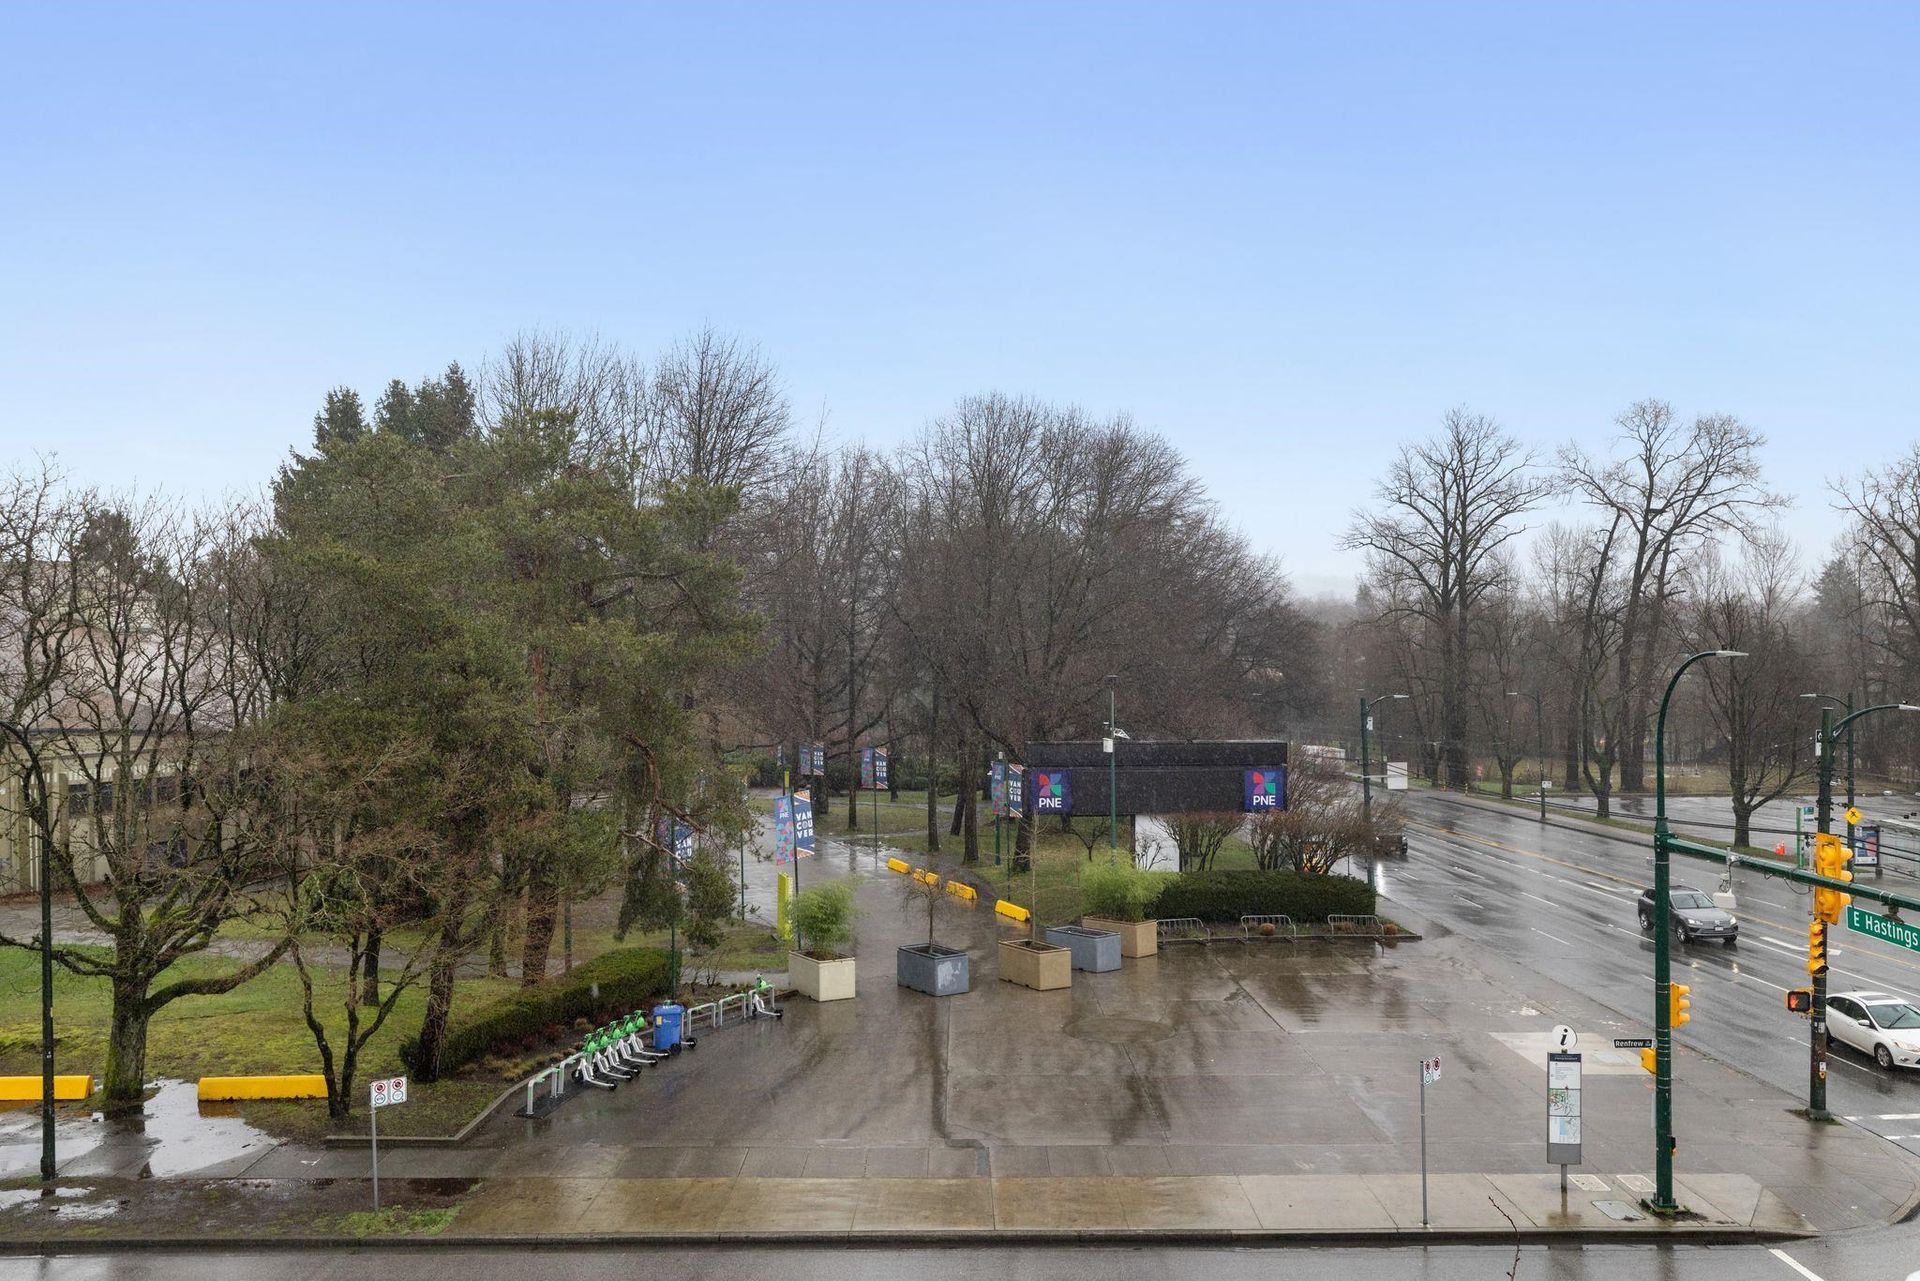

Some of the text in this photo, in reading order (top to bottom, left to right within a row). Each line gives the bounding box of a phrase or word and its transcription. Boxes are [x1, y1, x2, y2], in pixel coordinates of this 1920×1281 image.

[1009, 780, 1021, 788] VAN
[1039, 797, 1062, 808] PNE
[1253, 795, 1276, 806] PNE
[796, 810, 813, 821] VAN
[796, 819, 813, 830] COU
[797, 829, 814, 839] VER
[1853, 911, 1919, 948] E Hastings
